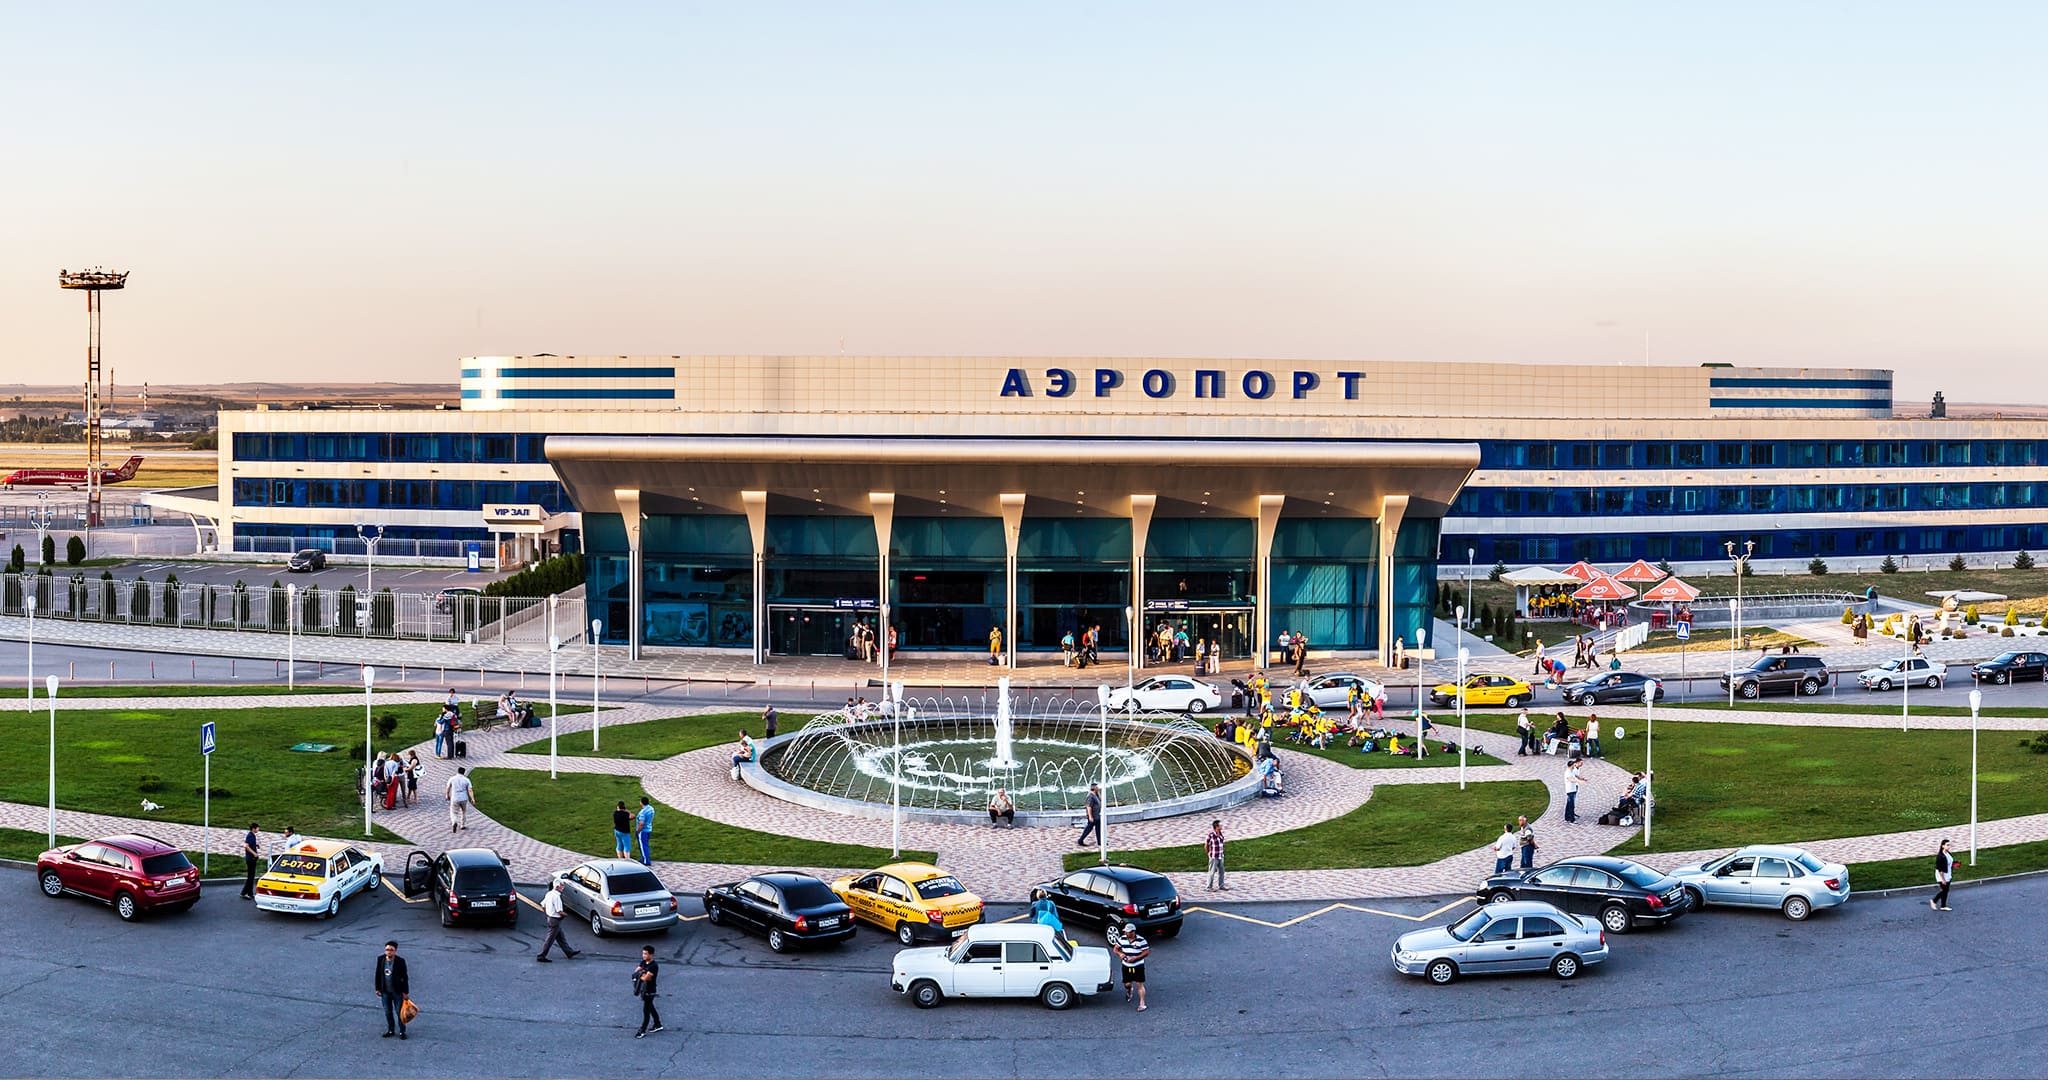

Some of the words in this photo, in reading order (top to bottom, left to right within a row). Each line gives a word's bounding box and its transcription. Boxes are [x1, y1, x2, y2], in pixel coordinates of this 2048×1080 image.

[1000, 368, 1364, 400] АЭРОПОРТ
[494, 508, 509, 516] VIP
[511, 508, 530, 516] ЗАЛ
[1147, 601, 1155, 609] 2
[280, 859, 320, 871] 5-07-07
